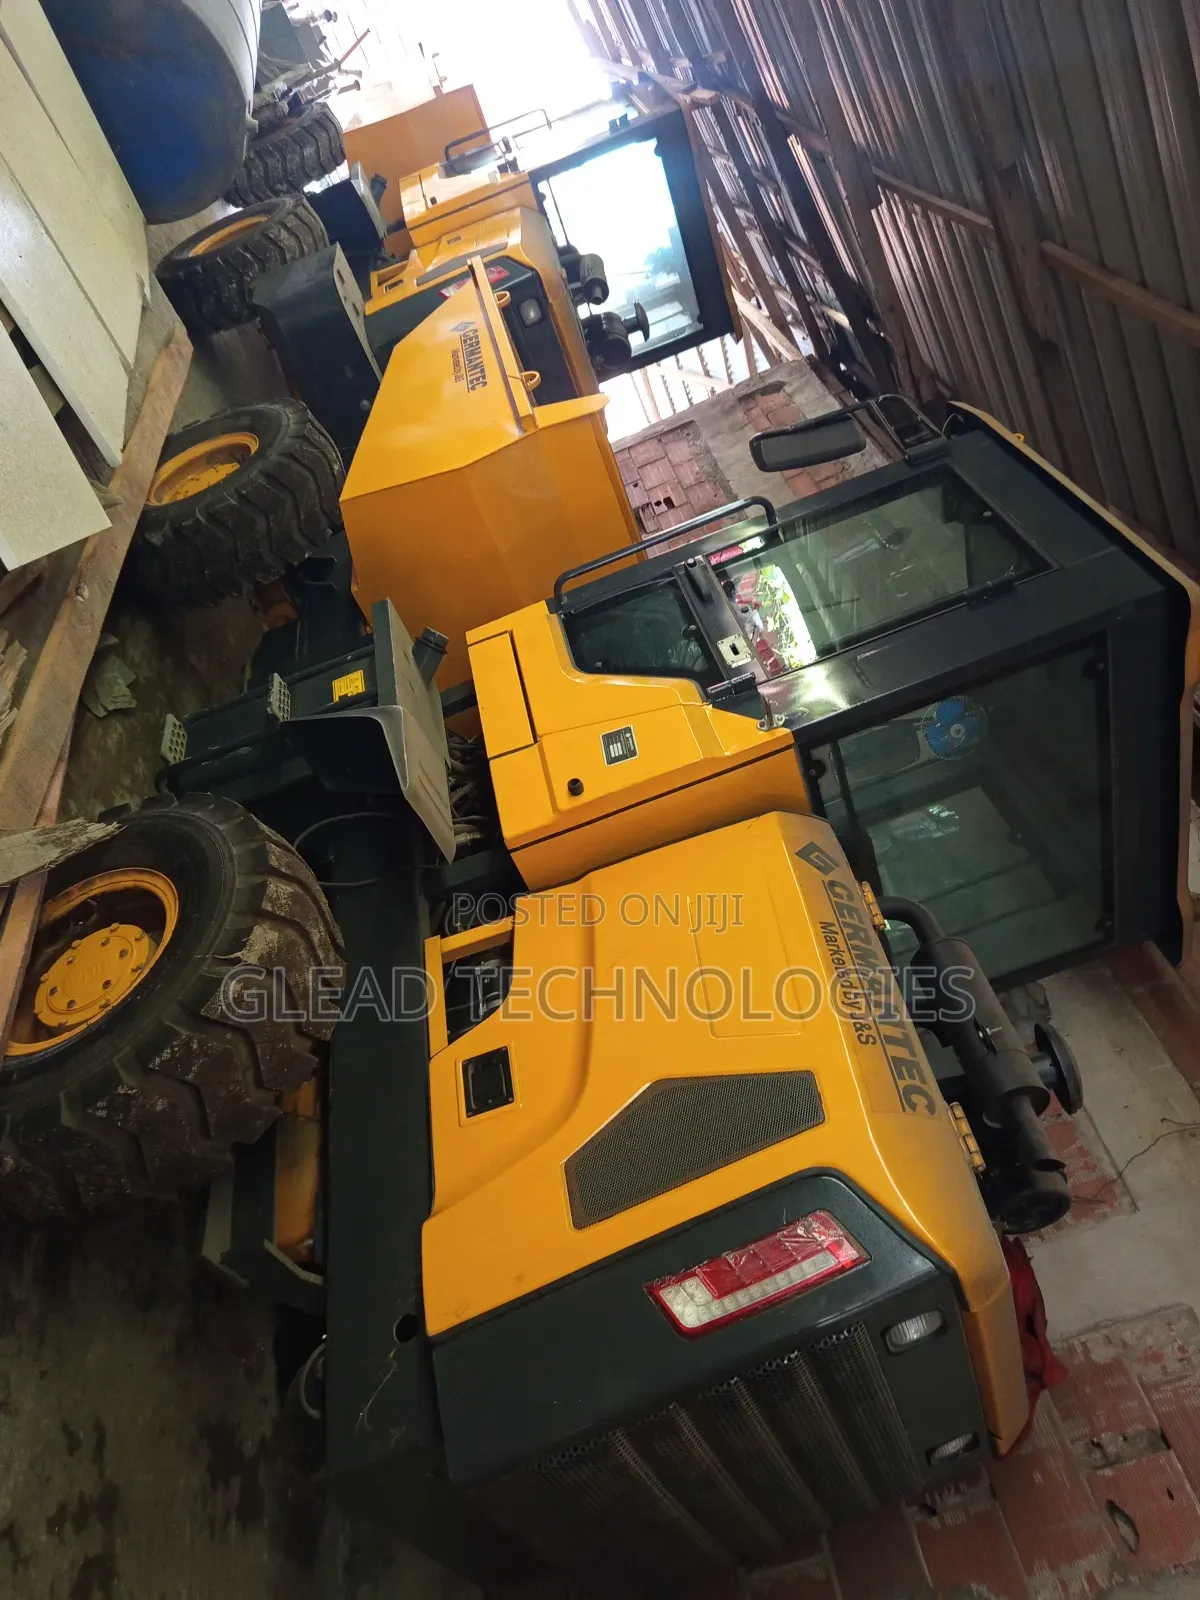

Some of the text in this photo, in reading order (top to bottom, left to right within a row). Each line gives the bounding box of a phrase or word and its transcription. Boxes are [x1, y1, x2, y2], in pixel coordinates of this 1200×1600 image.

[817, 921, 878, 1046] Marketed by J&S
[826, 879, 937, 1116] GERMANTEC
